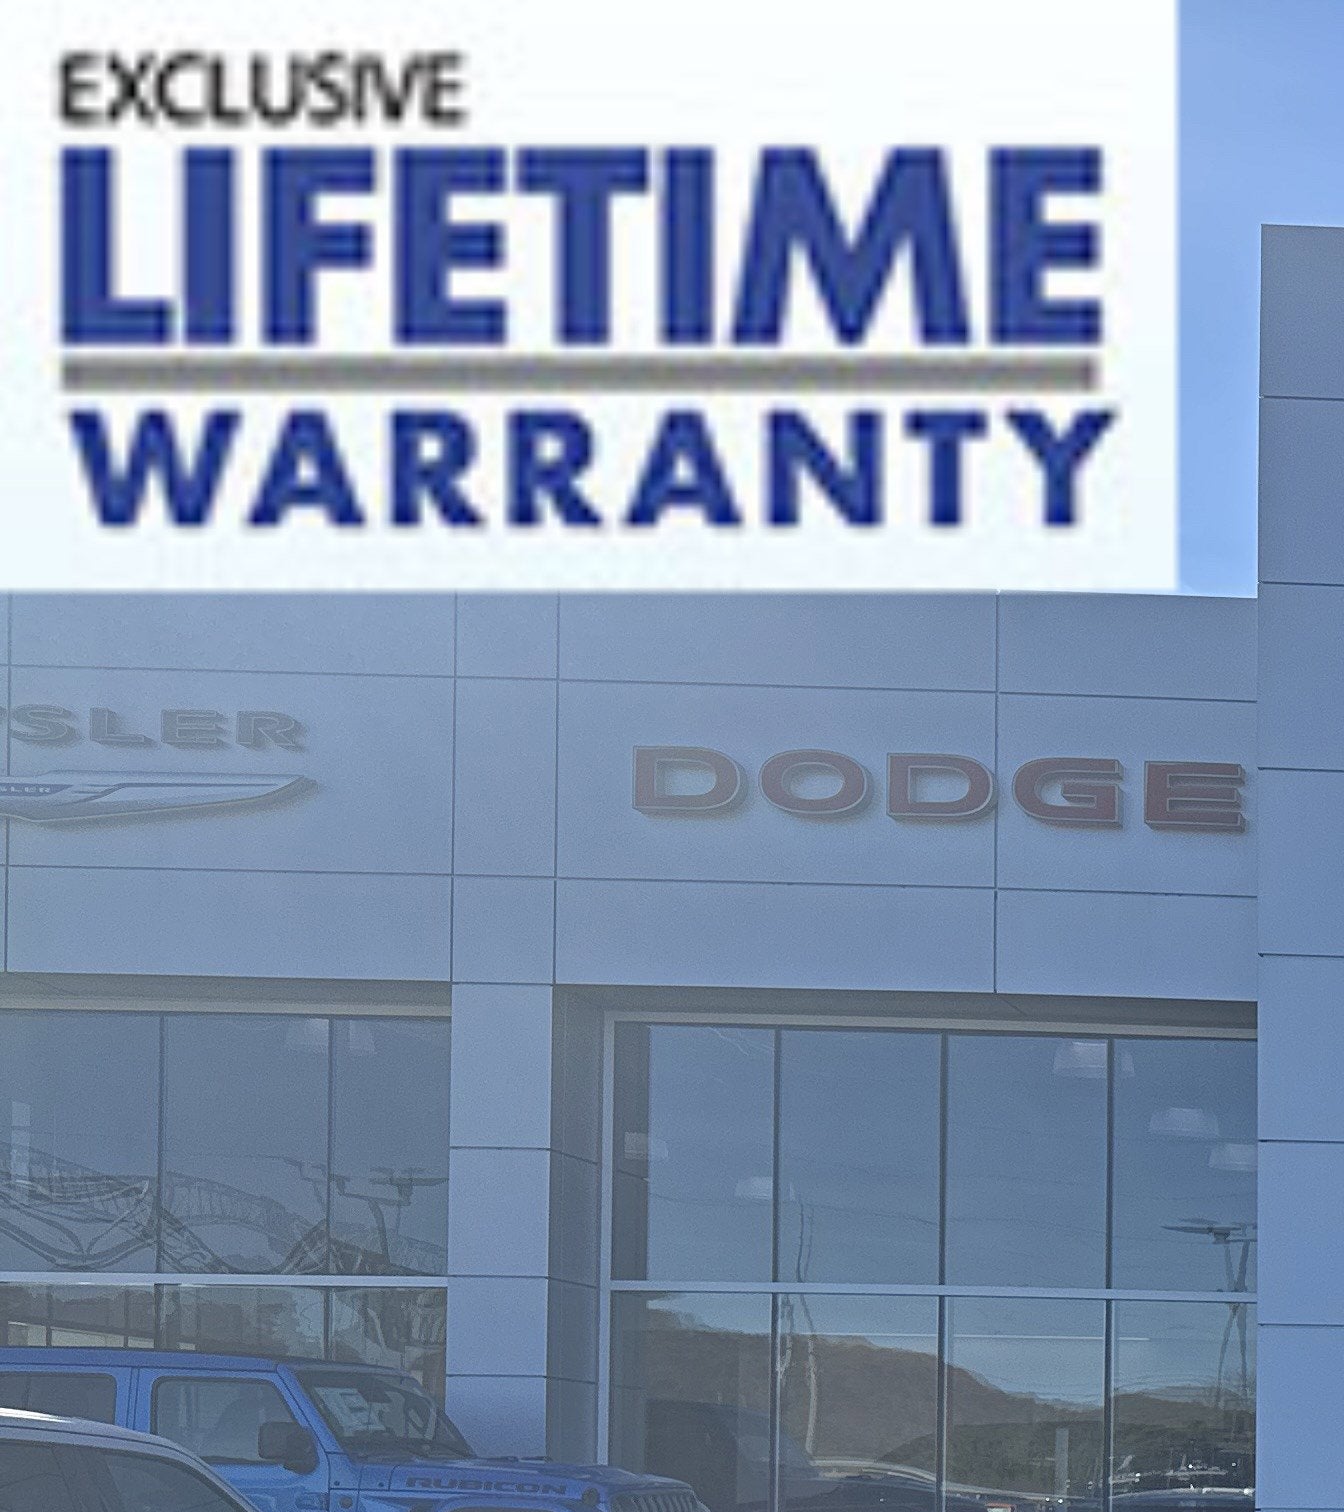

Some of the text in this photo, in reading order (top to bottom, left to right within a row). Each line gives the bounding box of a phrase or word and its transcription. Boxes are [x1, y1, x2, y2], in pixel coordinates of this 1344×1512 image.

[0, 703, 305, 752] SLER
[632, 745, 1246, 833] DODGE
[406, 1476, 567, 1494] RUBICON
